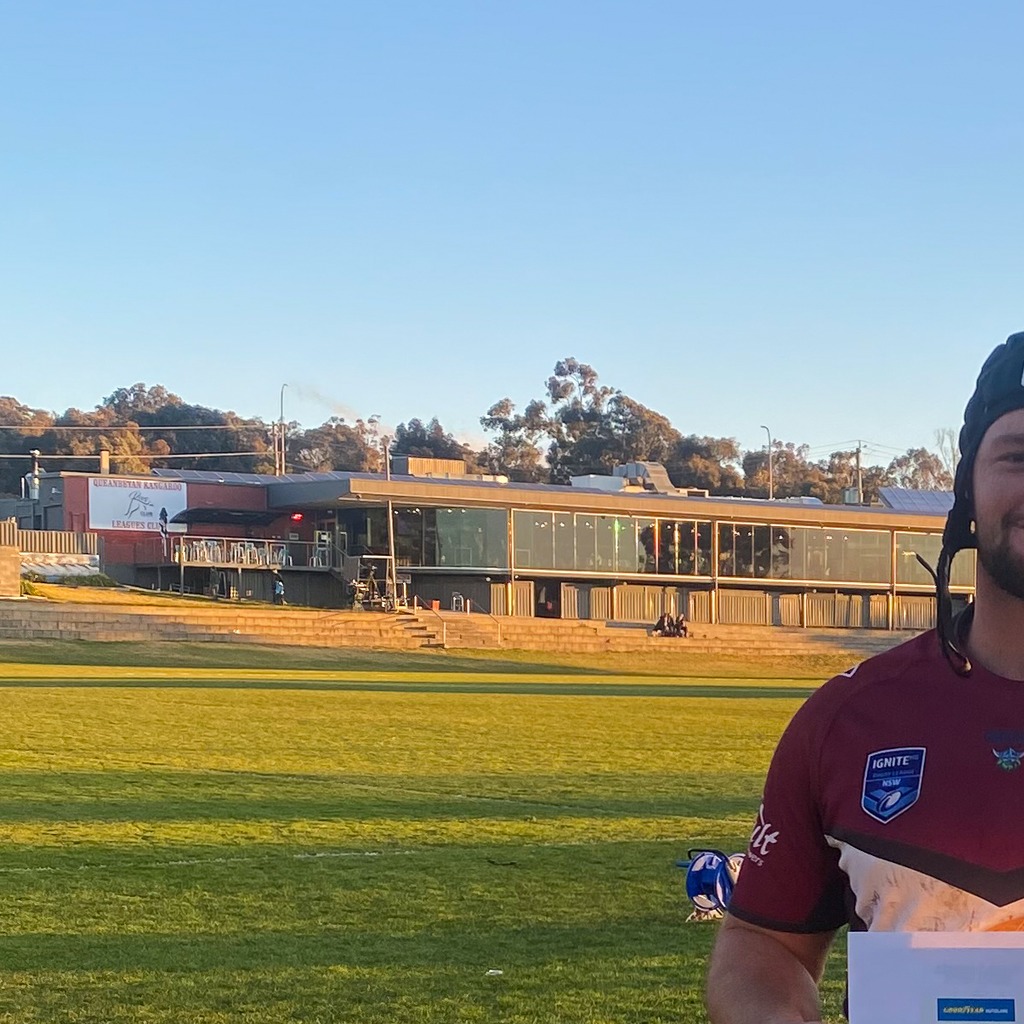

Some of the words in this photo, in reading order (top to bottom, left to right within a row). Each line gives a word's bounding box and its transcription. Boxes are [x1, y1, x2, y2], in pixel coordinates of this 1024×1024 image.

[111, 520, 146, 529] LEAGUES
[146, 521, 161, 530] CLU
[872, 755, 910, 769] IGNITE
[882, 778, 901, 787] NSW
